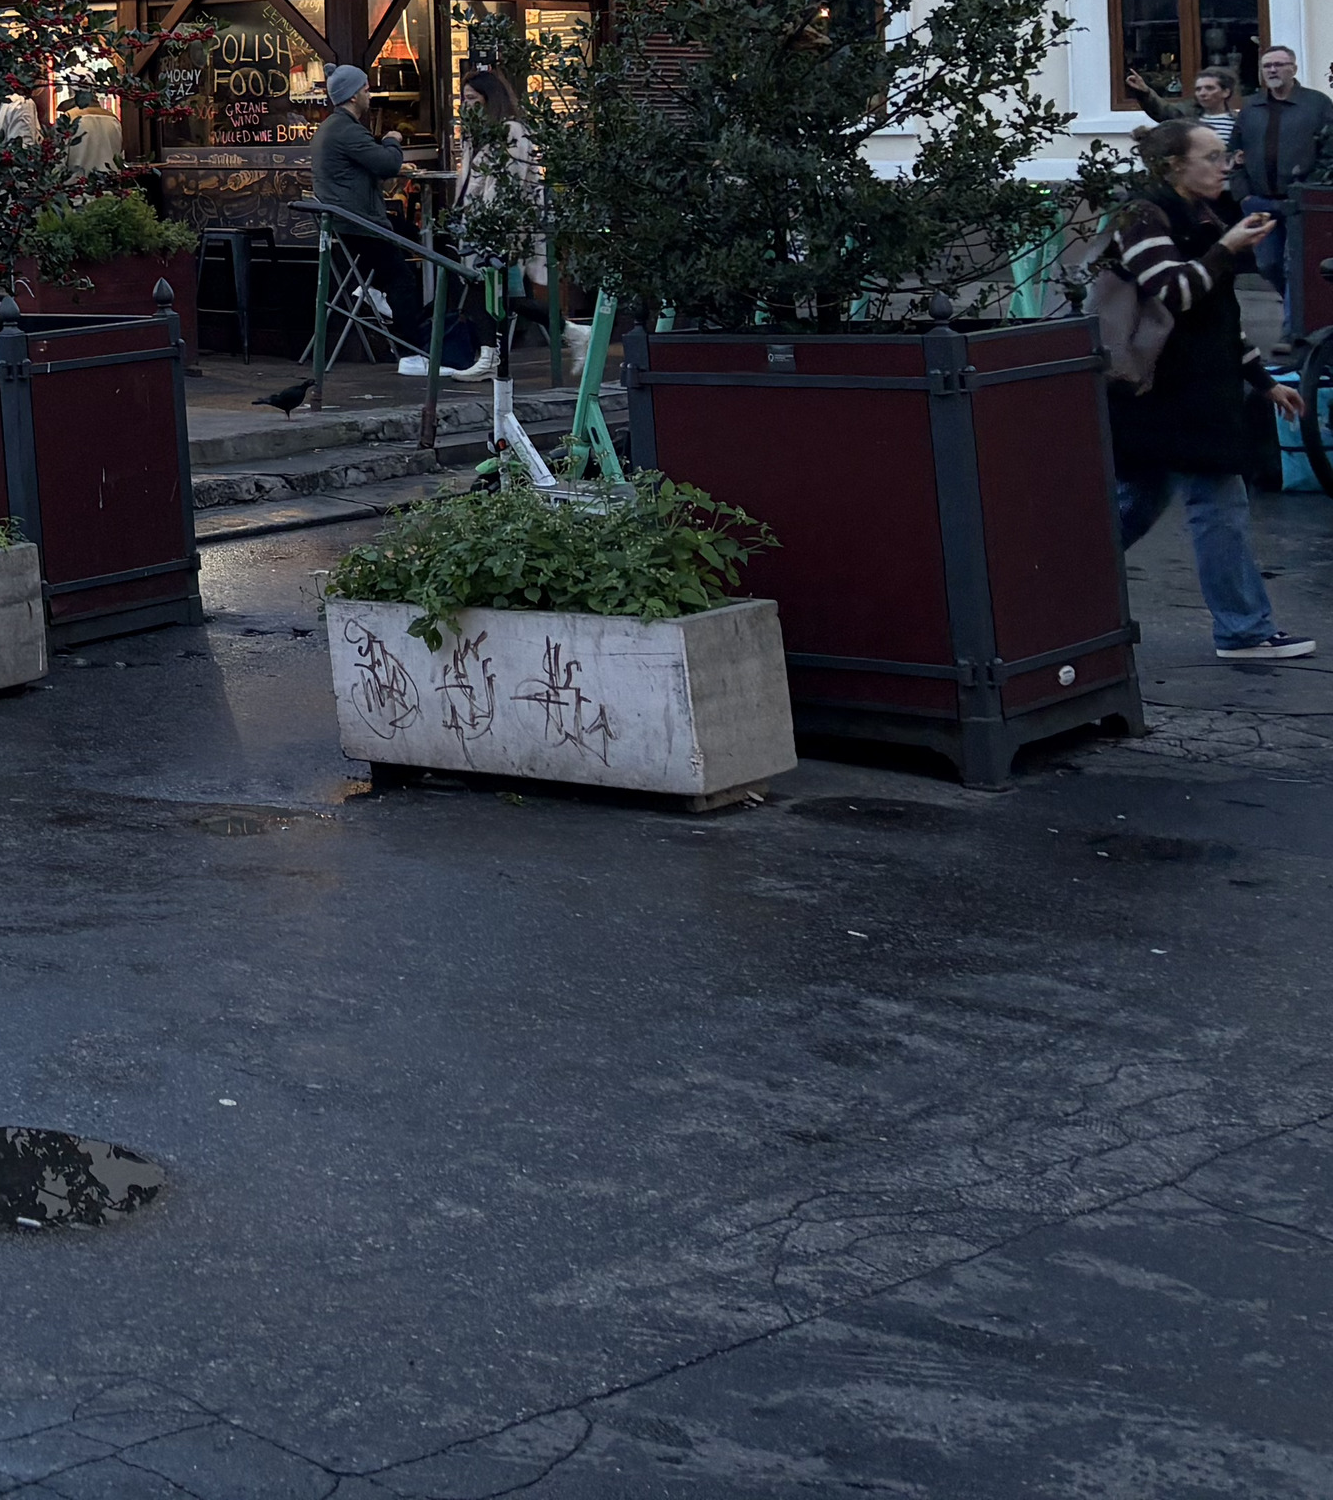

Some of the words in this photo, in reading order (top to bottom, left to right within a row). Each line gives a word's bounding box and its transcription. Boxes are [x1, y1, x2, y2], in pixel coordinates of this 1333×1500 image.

[207, 33, 295, 66] POLISH
[166, 69, 201, 85] MOCNY
[213, 68, 290, 98] FOOD
[169, 82, 195, 96] GAZ
[226, 102, 269, 116] GRZANE
[231, 114, 259, 127] WINO
[252, 129, 274, 143] WINE
